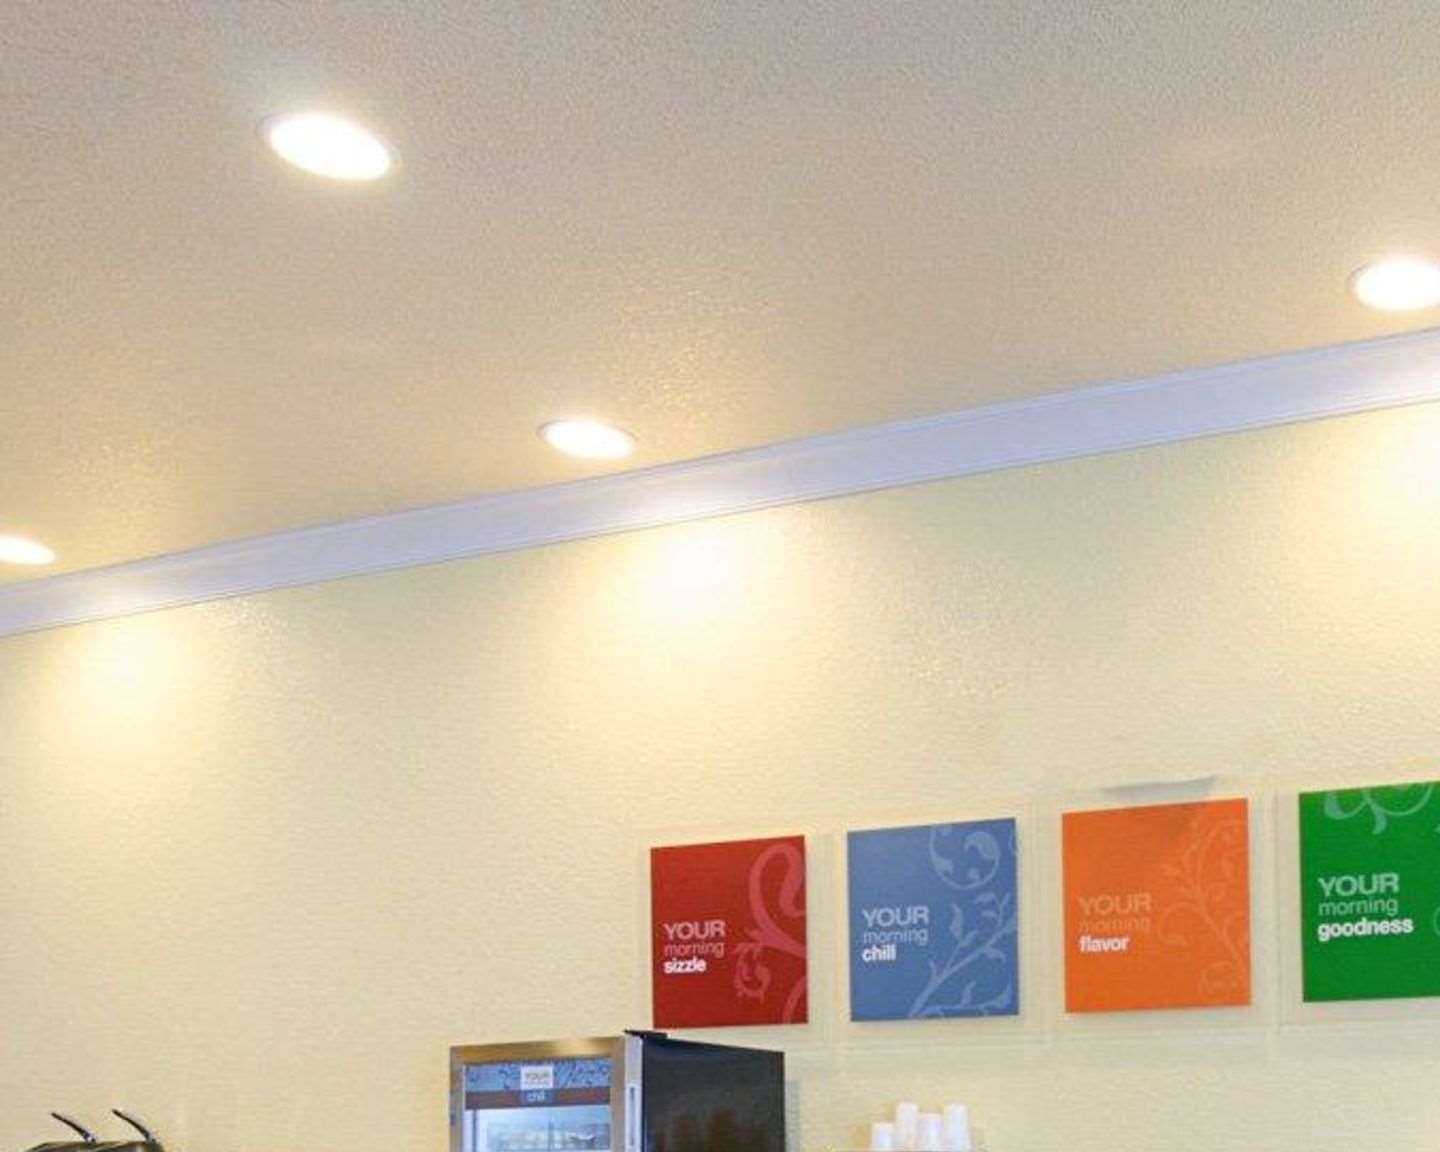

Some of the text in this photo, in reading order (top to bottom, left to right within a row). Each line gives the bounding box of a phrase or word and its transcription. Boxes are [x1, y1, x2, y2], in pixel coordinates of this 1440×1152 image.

[1317, 872, 1399, 897] YOUR
[1079, 891, 1152, 915] YOUR
[1318, 896, 1398, 917] morning
[861, 906, 929, 929] YOUR
[662, 919, 726, 941] YOUR
[863, 927, 929, 948] morning
[1317, 916, 1415, 942] goodness
[663, 940, 725, 959] morning
[861, 943, 897, 963] chill
[1080, 934, 1130, 953] flavor
[663, 955, 707, 975] sizzle
